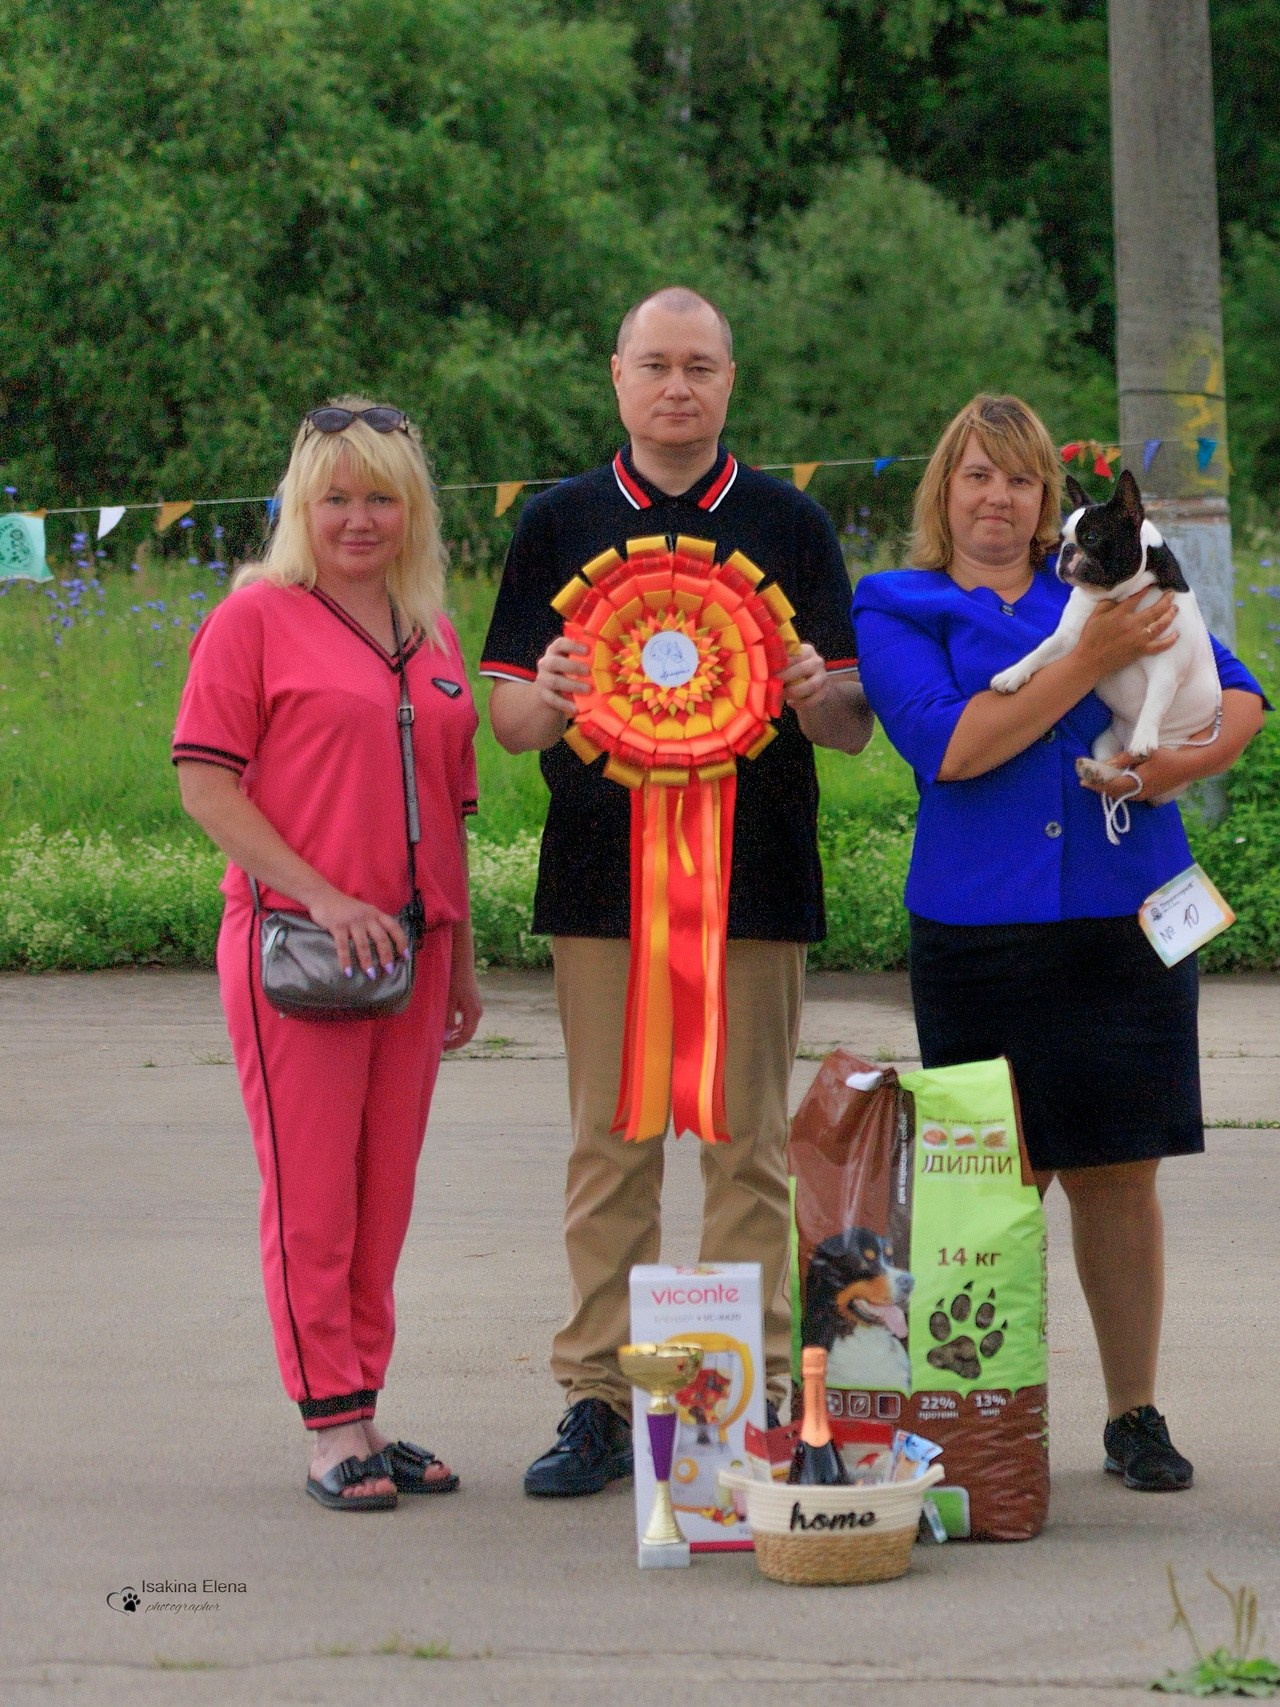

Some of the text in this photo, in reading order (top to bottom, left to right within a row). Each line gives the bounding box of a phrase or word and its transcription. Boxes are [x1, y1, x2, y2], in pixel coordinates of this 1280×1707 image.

[921, 1155, 1013, 1175] ДИЛЛИ
[937, 1248, 1002, 1266] 14 кг
[651, 1284, 739, 1305] viconte
[921, 1396, 956, 1410] 22%
[975, 1394, 1007, 1408] 13%
[789, 1501, 877, 1531] home
